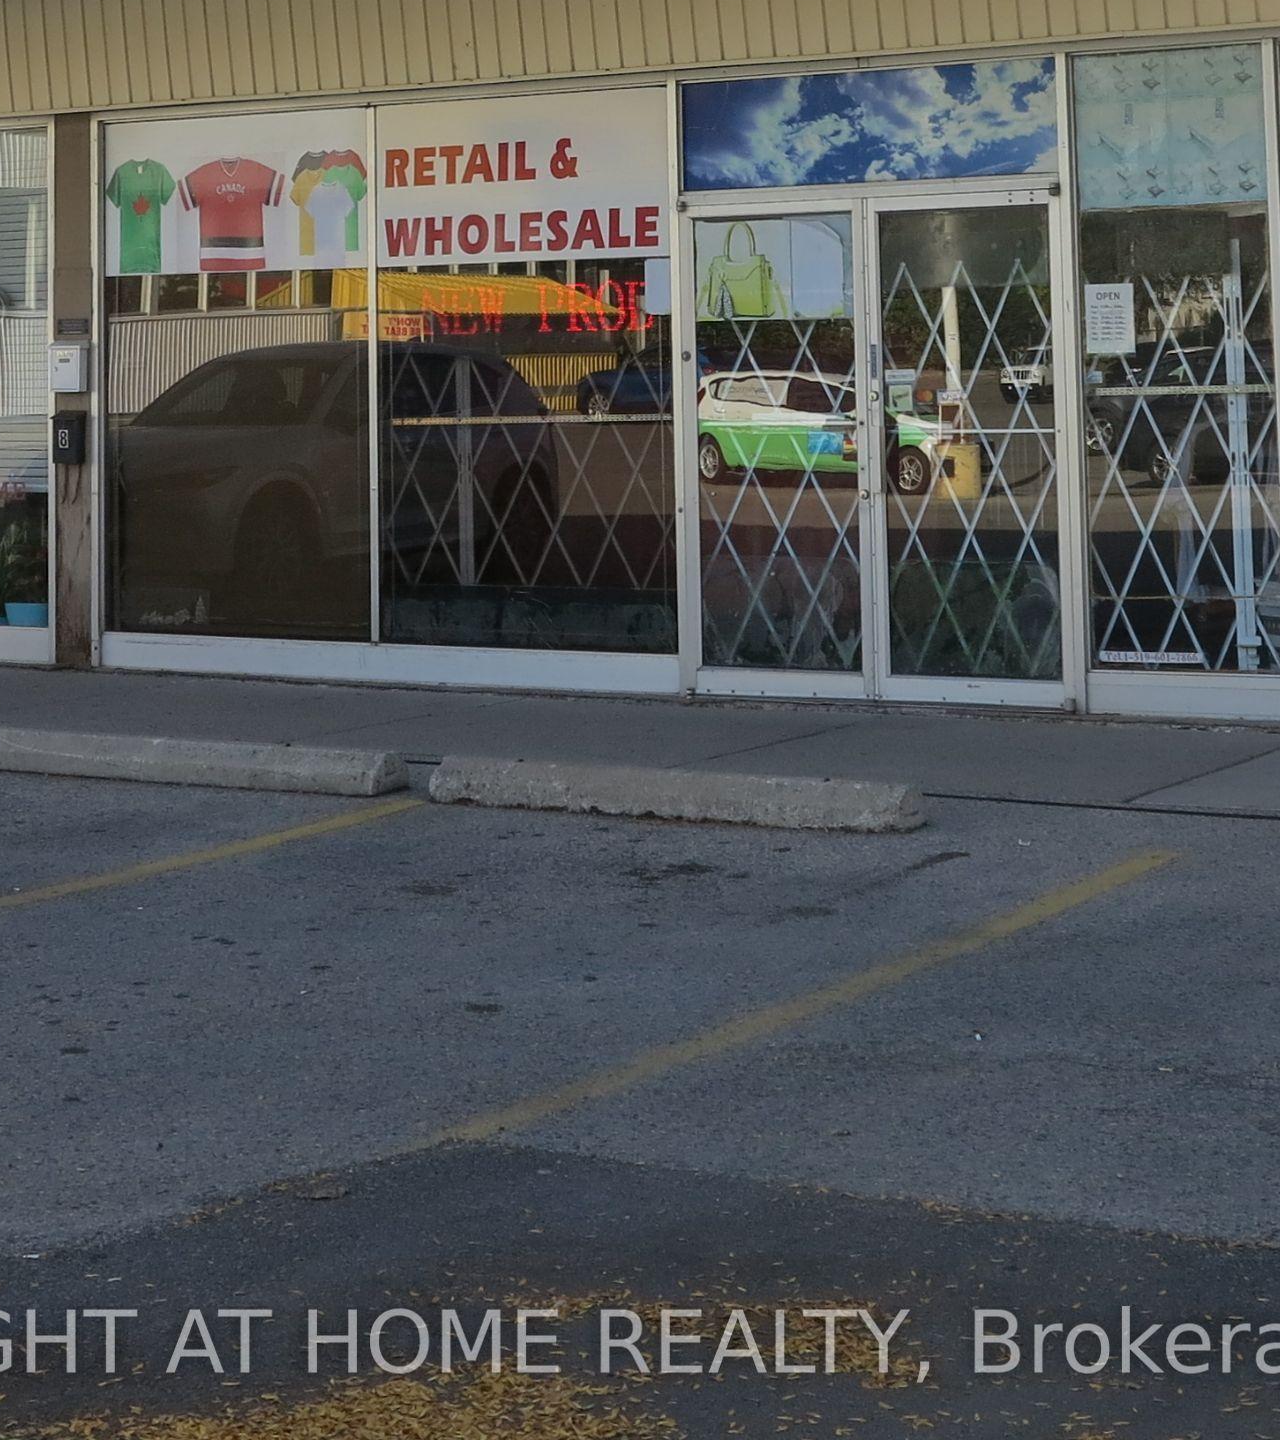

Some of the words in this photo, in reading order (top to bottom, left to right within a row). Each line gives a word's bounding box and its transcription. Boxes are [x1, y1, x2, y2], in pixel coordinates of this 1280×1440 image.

[385, 140, 537, 188] RETAIL
[550, 138, 578, 179] &
[216, 183, 246, 195] CANADA
[385, 207, 660, 257] WHOLESALE
[421, 285, 507, 334] NEW
[1096, 292, 1121, 301] OPEN
[59, 430, 68, 448] 8
